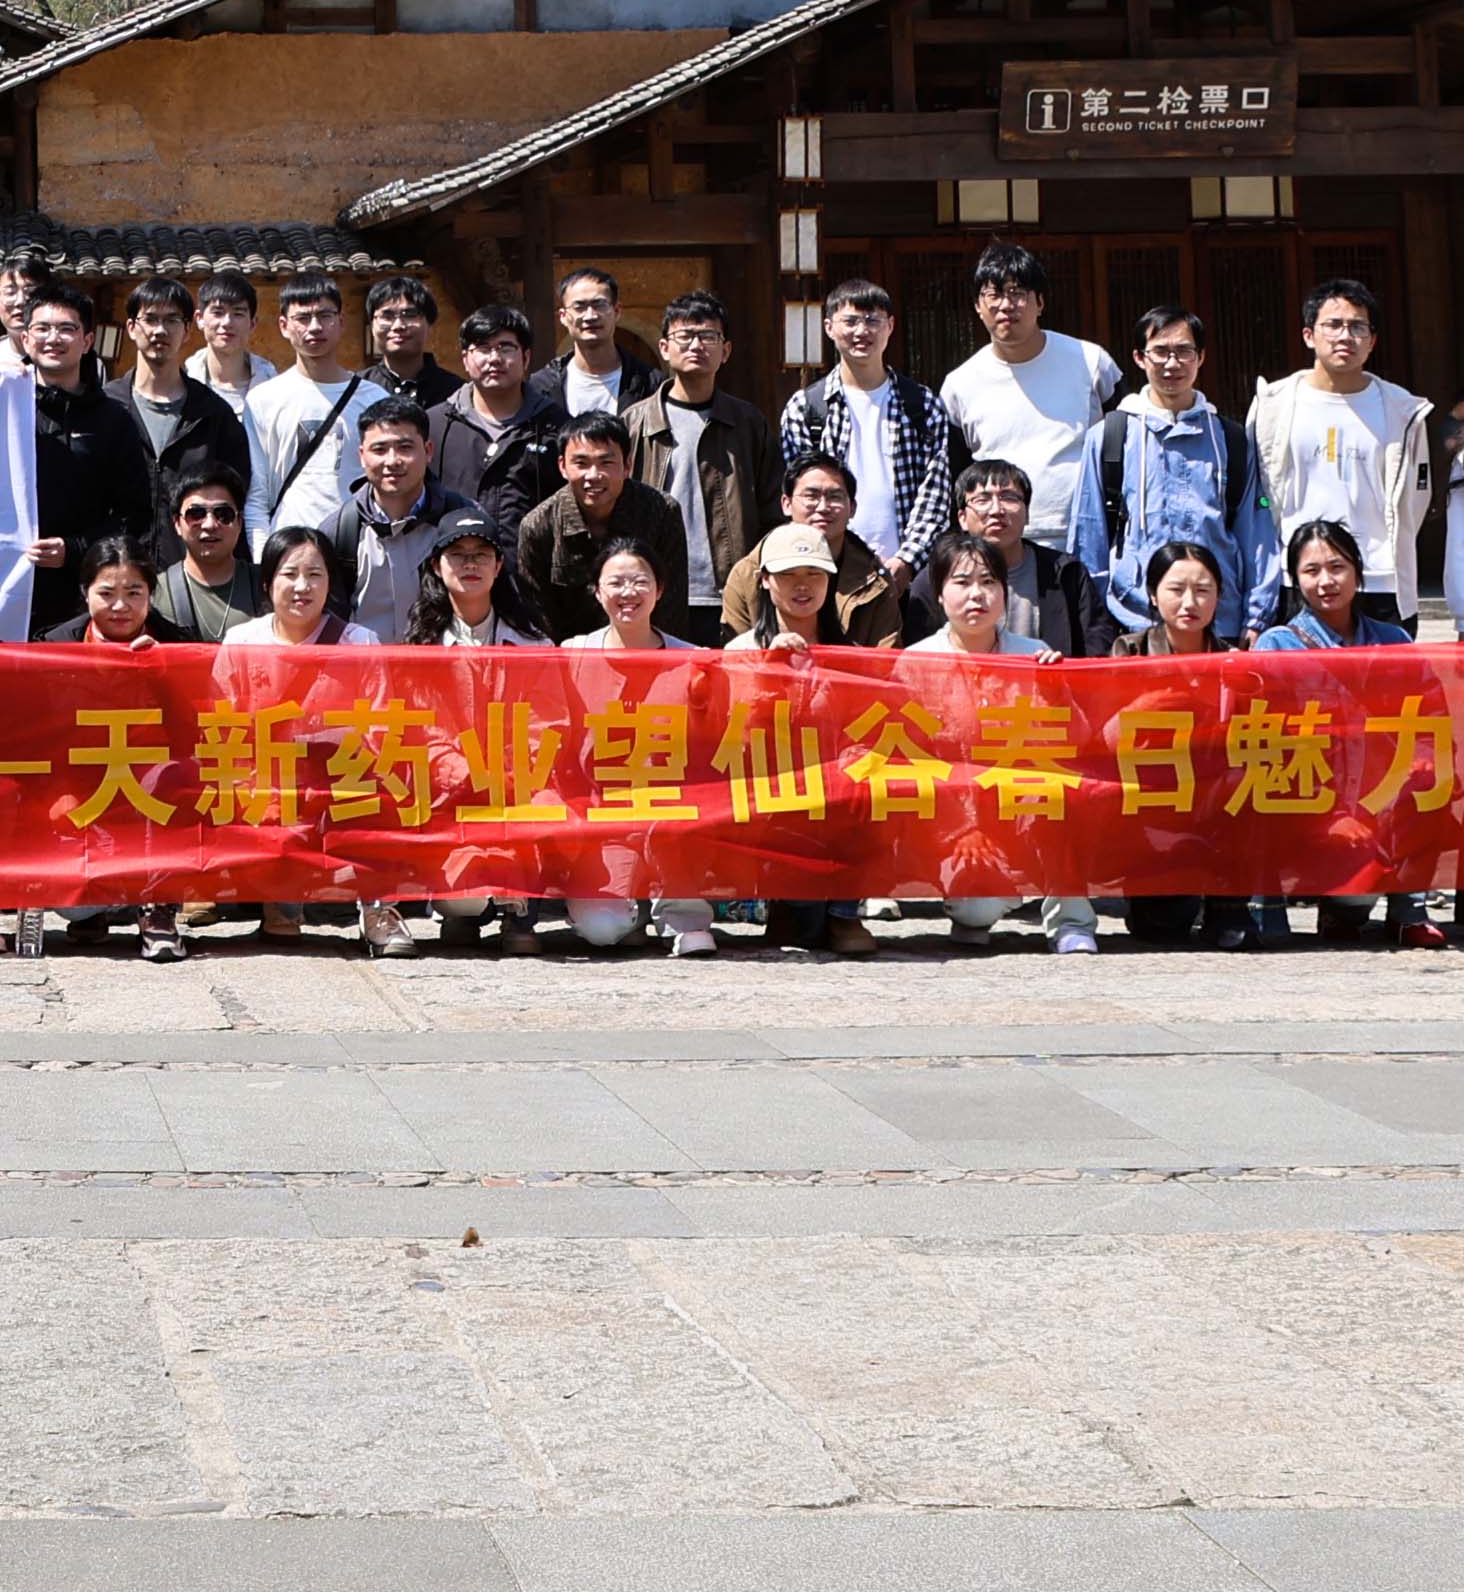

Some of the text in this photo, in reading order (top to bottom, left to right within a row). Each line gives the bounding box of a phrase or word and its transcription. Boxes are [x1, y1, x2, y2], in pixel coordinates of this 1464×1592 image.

[1080, 84, 1270, 117] 第二检票口
[1081, 118, 1267, 133] SECOND TICKET CHECKPOINT
